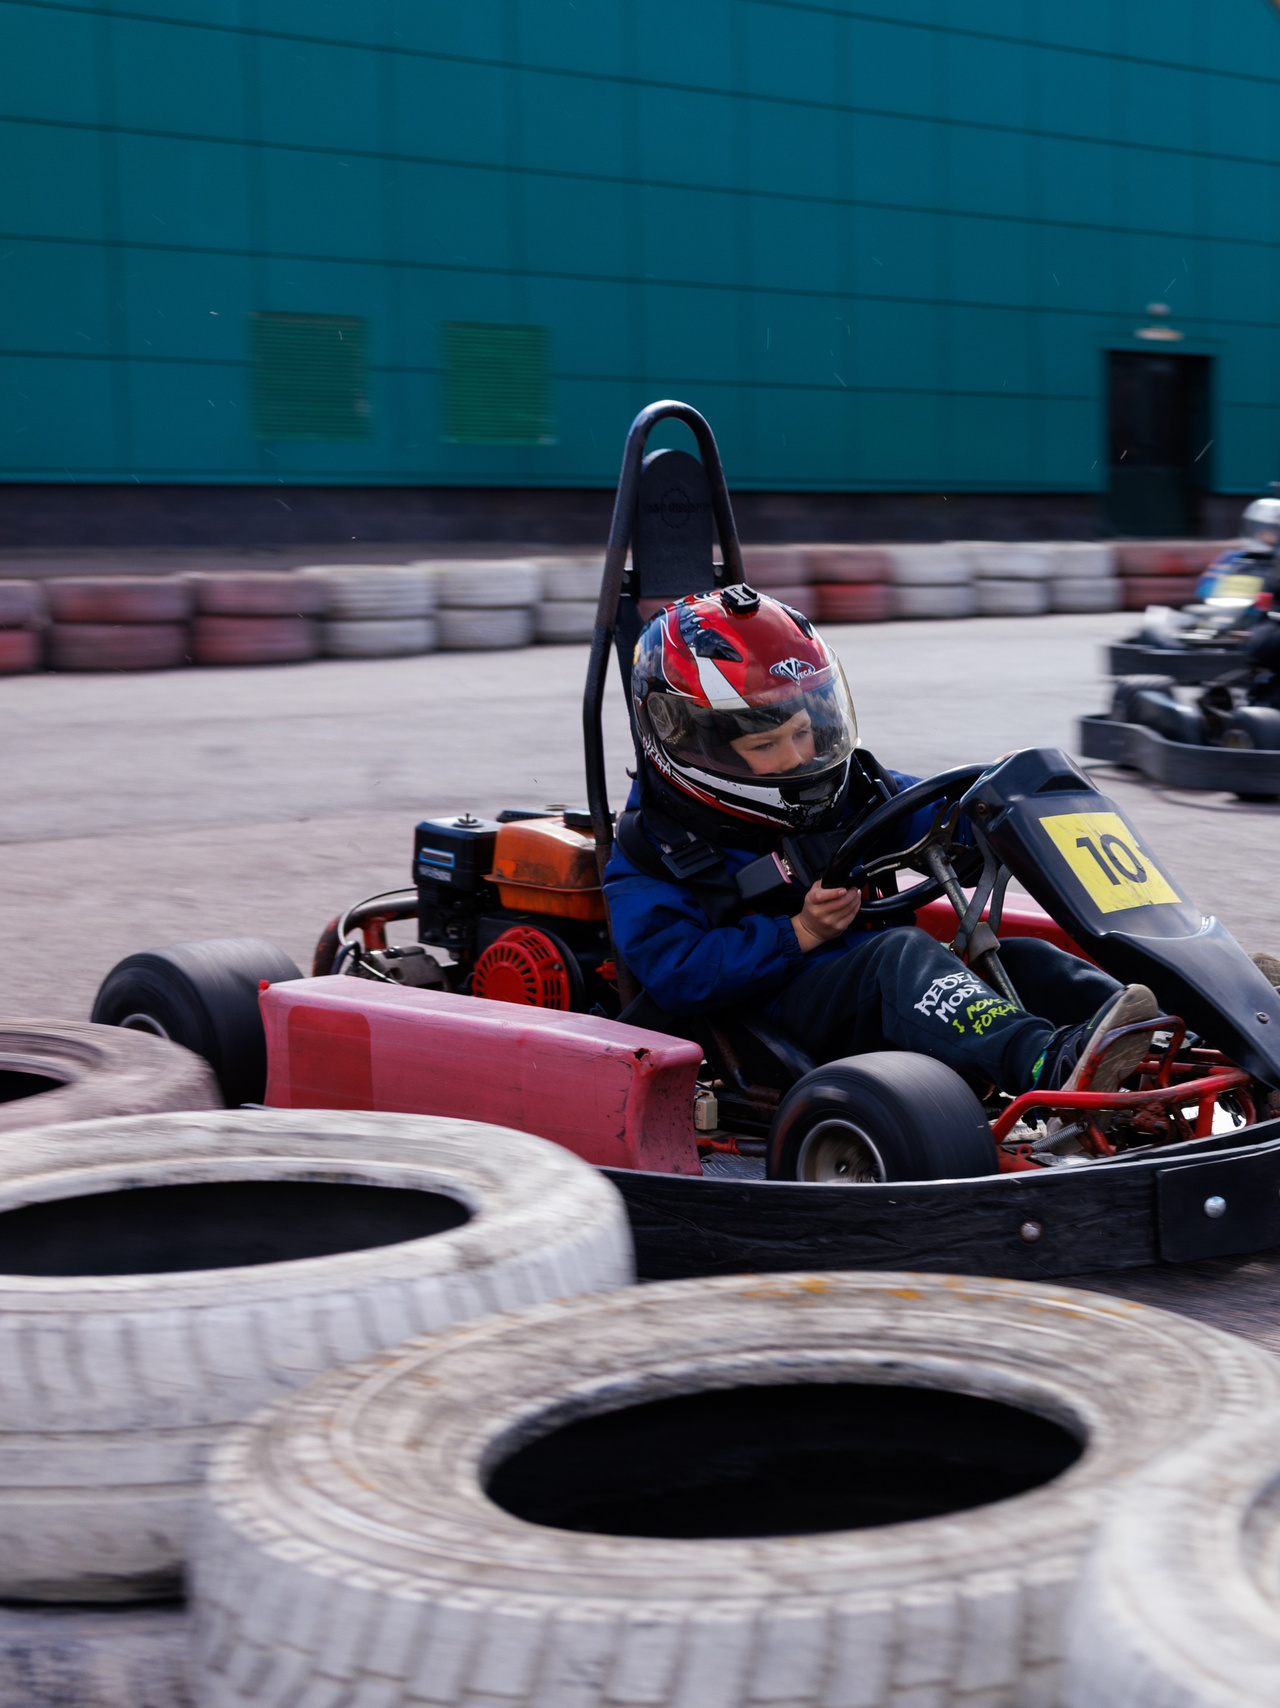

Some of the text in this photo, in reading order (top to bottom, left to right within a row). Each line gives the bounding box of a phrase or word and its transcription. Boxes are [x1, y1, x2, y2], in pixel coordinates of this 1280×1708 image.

[1075, 833, 1148, 886] 10
[914, 972, 980, 1016] REBEL
[935, 984, 987, 1023] MODE
